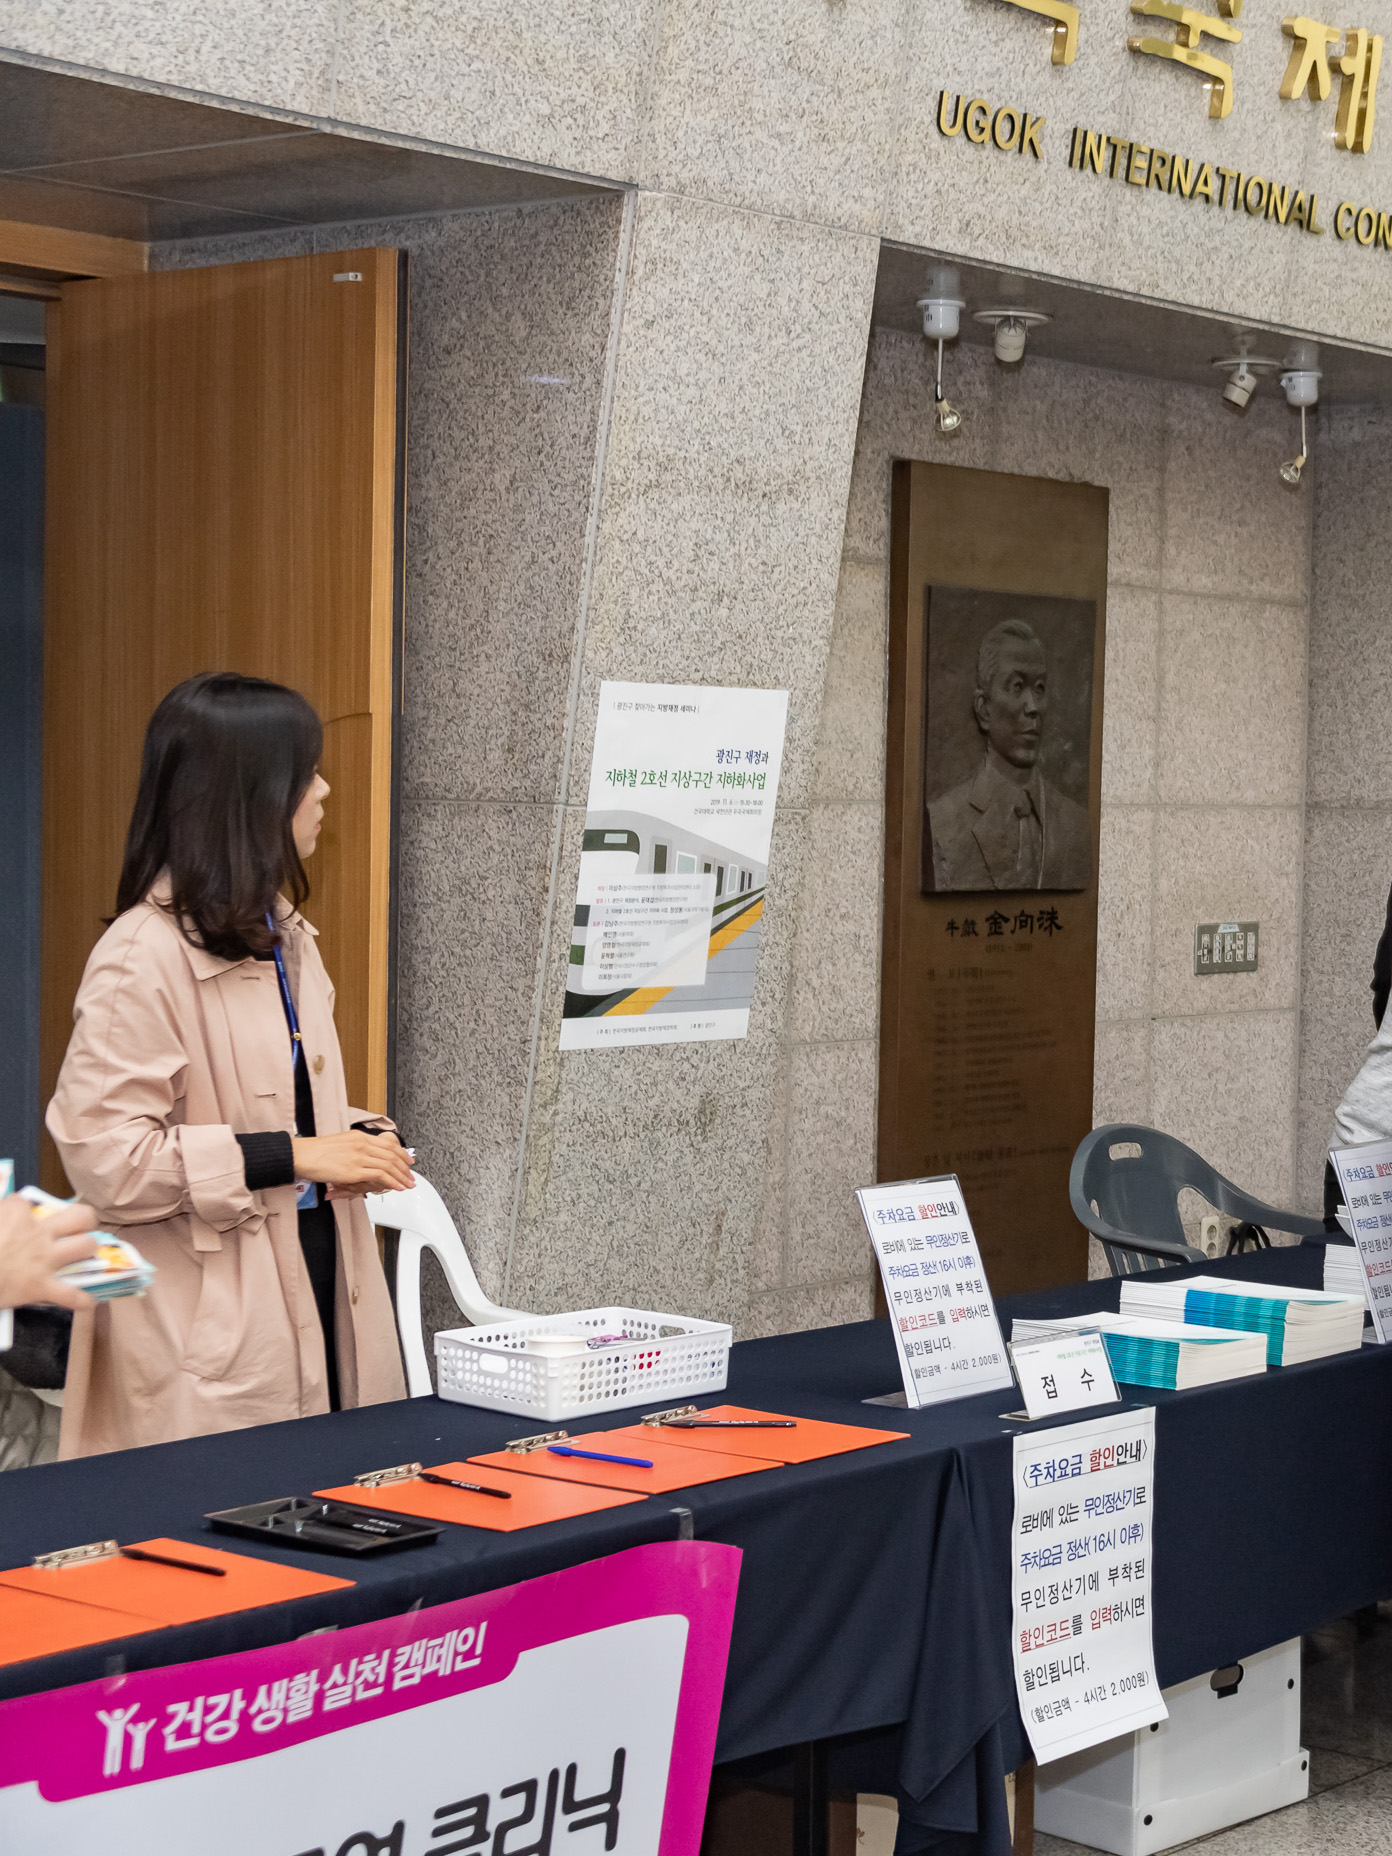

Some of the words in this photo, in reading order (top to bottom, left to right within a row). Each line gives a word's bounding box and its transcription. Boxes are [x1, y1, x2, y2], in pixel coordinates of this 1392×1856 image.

[937, 90, 1047, 160] UGOK
[1069, 126, 1324, 235] INTERNATIONAL
[715, 748, 742, 764] 광진구
[744, 749, 769, 764] 재정과
[604, 768, 637, 787] 지하철
[639, 769, 668, 788] 2호선
[669, 770, 713, 788] 지상구간
[715, 771, 766, 789] 지하화사업
[1370, 1193, 1382, 1205] 있는
[882, 1239, 906, 1254] 로비에
[907, 1238, 924, 1251] 있는
[925, 1232, 970, 1248] 무인정산기로
[888, 1263, 919, 1279] 주차요금
[920, 1258, 956, 1276] 정산(16시
[958, 1256, 976, 1269] 이후)
[894, 1284, 952, 1305] 무인정산기에
[956, 1279, 983, 1295] 부착된
[899, 1311, 946, 1332] 할인코드를
[950, 1303, 990, 1323] 입력하시면
[905, 1336, 955, 1358] 할인됩니다.
[951, 1360, 969, 1371] 4시간
[1041, 1374, 1058, 1399] 접
[1080, 1368, 1095, 1391] 수
[1020, 1508, 1054, 1535] 로비에
[1058, 1503, 1080, 1526] 있는
[1084, 1487, 1147, 1518] 무인정산기로
[1020, 1544, 1062, 1573] 주차요금
[1067, 1529, 1115, 1562] 정산(16시
[1120, 1523, 1144, 1545] 이후)
[1021, 1571, 1100, 1612] 무인정산기에
[1108, 1558, 1145, 1587] 부착된
[1020, 1614, 1083, 1653] 할인코드를
[1090, 1595, 1145, 1630] 입력하시면
[162, 1688, 245, 1752] 건강
[247, 1671, 321, 1734] 생활
[322, 1648, 389, 1712] 실천
[391, 1621, 489, 1691] 캠페인
[1023, 1652, 1089, 1691] 할인됩니다.
[1031, 1697, 1072, 1723] (할인금액
[1084, 1684, 1107, 1707] 4시간
[422, 1747, 627, 1856] 클리닉
